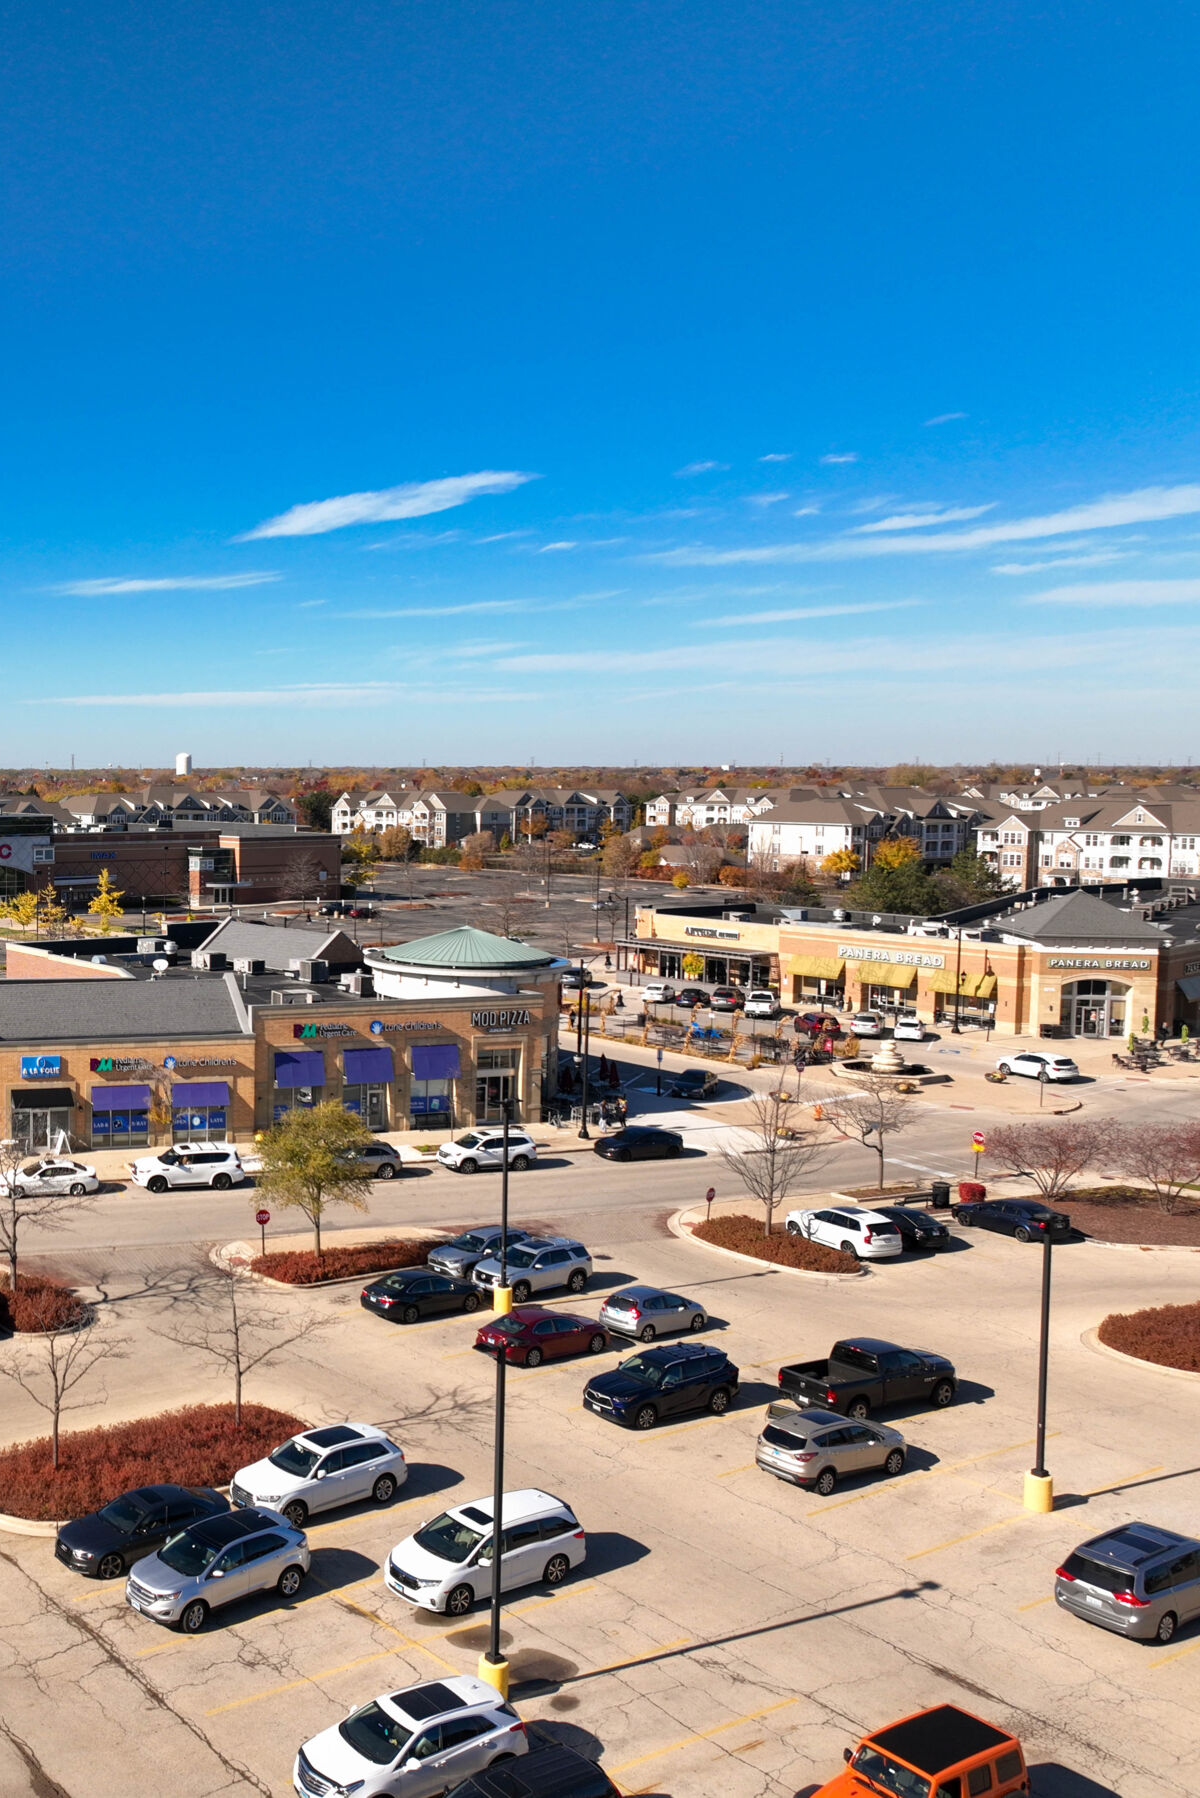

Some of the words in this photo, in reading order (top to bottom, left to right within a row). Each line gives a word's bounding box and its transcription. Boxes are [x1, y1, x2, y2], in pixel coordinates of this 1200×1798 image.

[839, 946, 890, 961] PANERA
[896, 952, 942, 967] BREAD
[1050, 959, 1099, 968] PANERA
[1106, 960, 1148, 968] BREAD
[472, 1011, 497, 1027] MOD
[500, 1010, 530, 1025] PIZZA
[341, 1029, 357, 1037] Care
[22, 1067, 28, 1075] A
[29, 1067, 38, 1075] LA
[40, 1066, 60, 1075] FOLIE
